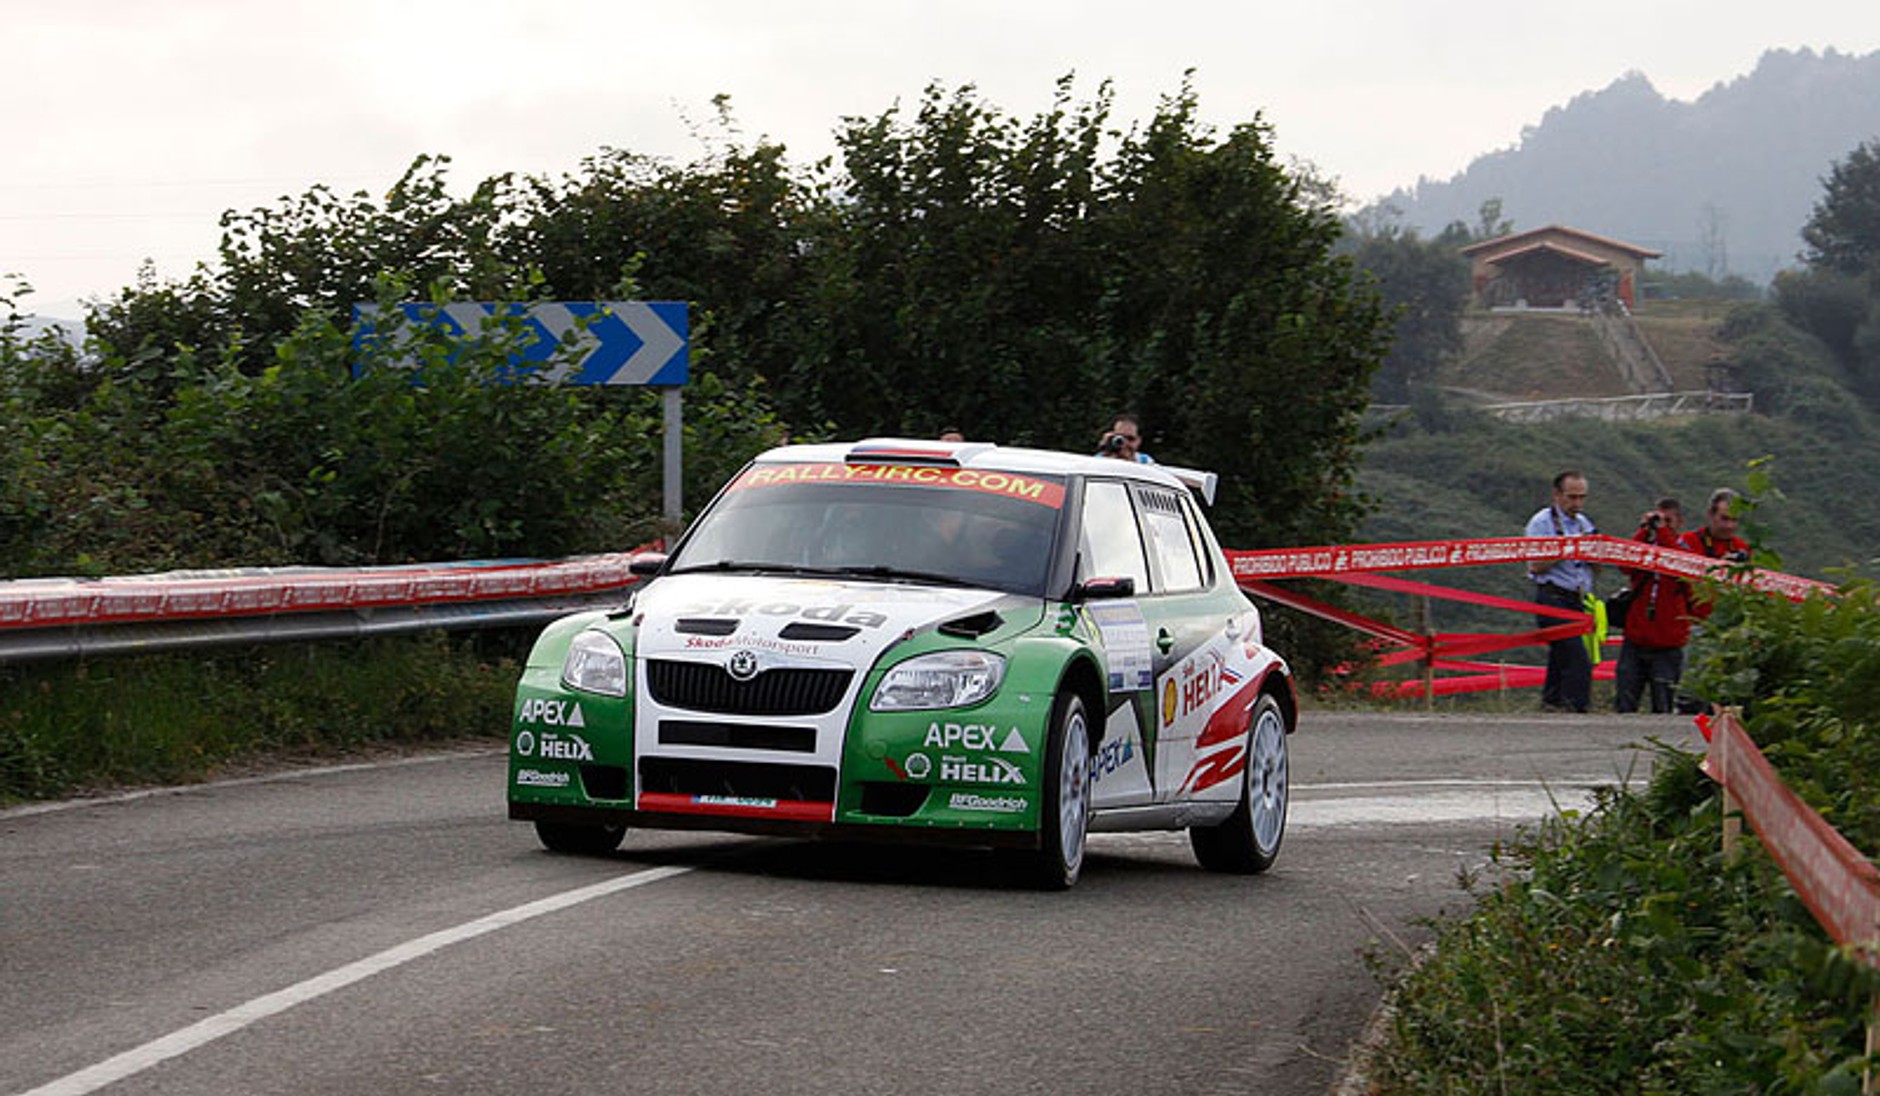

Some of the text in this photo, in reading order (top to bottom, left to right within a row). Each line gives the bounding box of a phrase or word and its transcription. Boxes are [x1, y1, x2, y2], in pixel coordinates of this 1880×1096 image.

[747, 465, 1045, 497] RALLY-IRC.COM
[1233, 554, 1287, 575] PROHIBIDO
[1288, 552, 1331, 572] PUBLICO
[1351, 549, 1404, 567] PROHIBIDO
[1405, 546, 1447, 565] PUBLICO
[519, 698, 567, 726] APEX
[540, 736, 595, 761] HELIX
[923, 721, 996, 751] APEX
[940, 758, 1028, 784] HELIX
